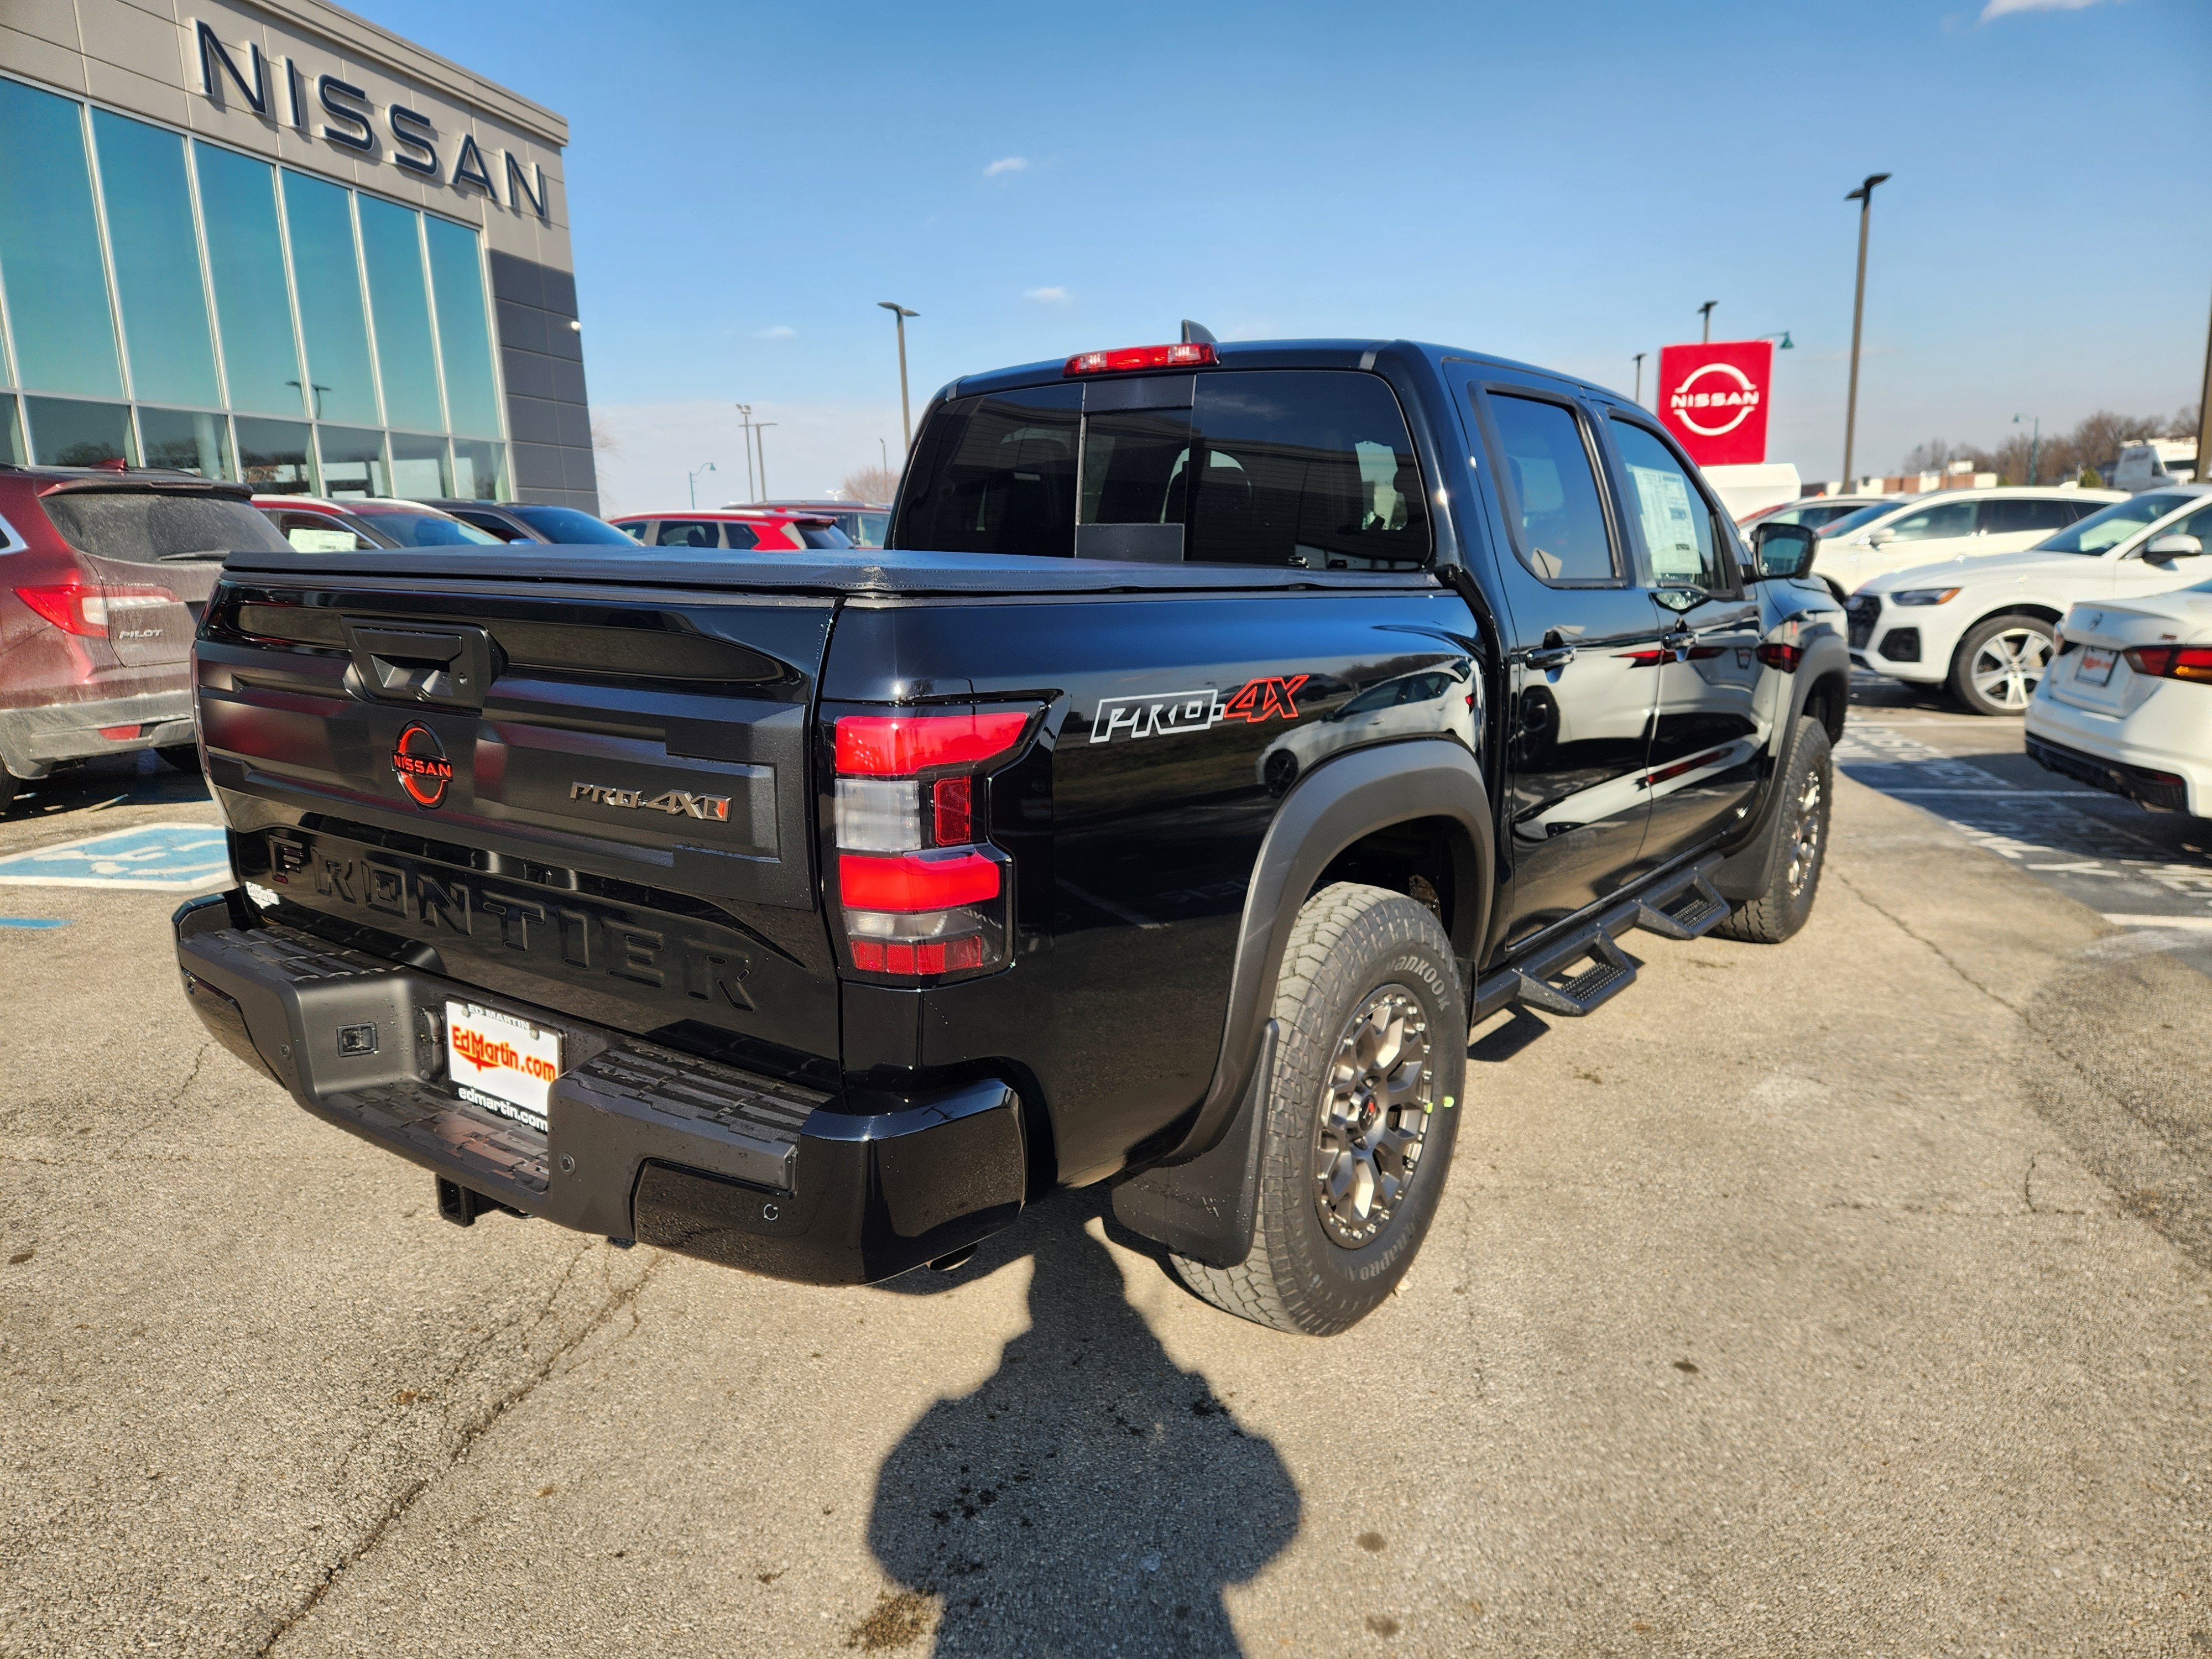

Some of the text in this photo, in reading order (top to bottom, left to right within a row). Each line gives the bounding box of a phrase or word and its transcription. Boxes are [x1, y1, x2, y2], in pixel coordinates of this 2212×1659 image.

[190, 17, 549, 220] NISSAN
[1671, 390, 1760, 408] NISSAN
[119, 629, 164, 639] PILOT
[1089, 674, 1310, 744] PRO-4X
[394, 754, 451, 778] NISSAN
[269, 834, 758, 1013] FRONTIER
[468, 1003, 529, 1031] ED MARTIN
[458, 1087, 548, 1132] edmartin.com
